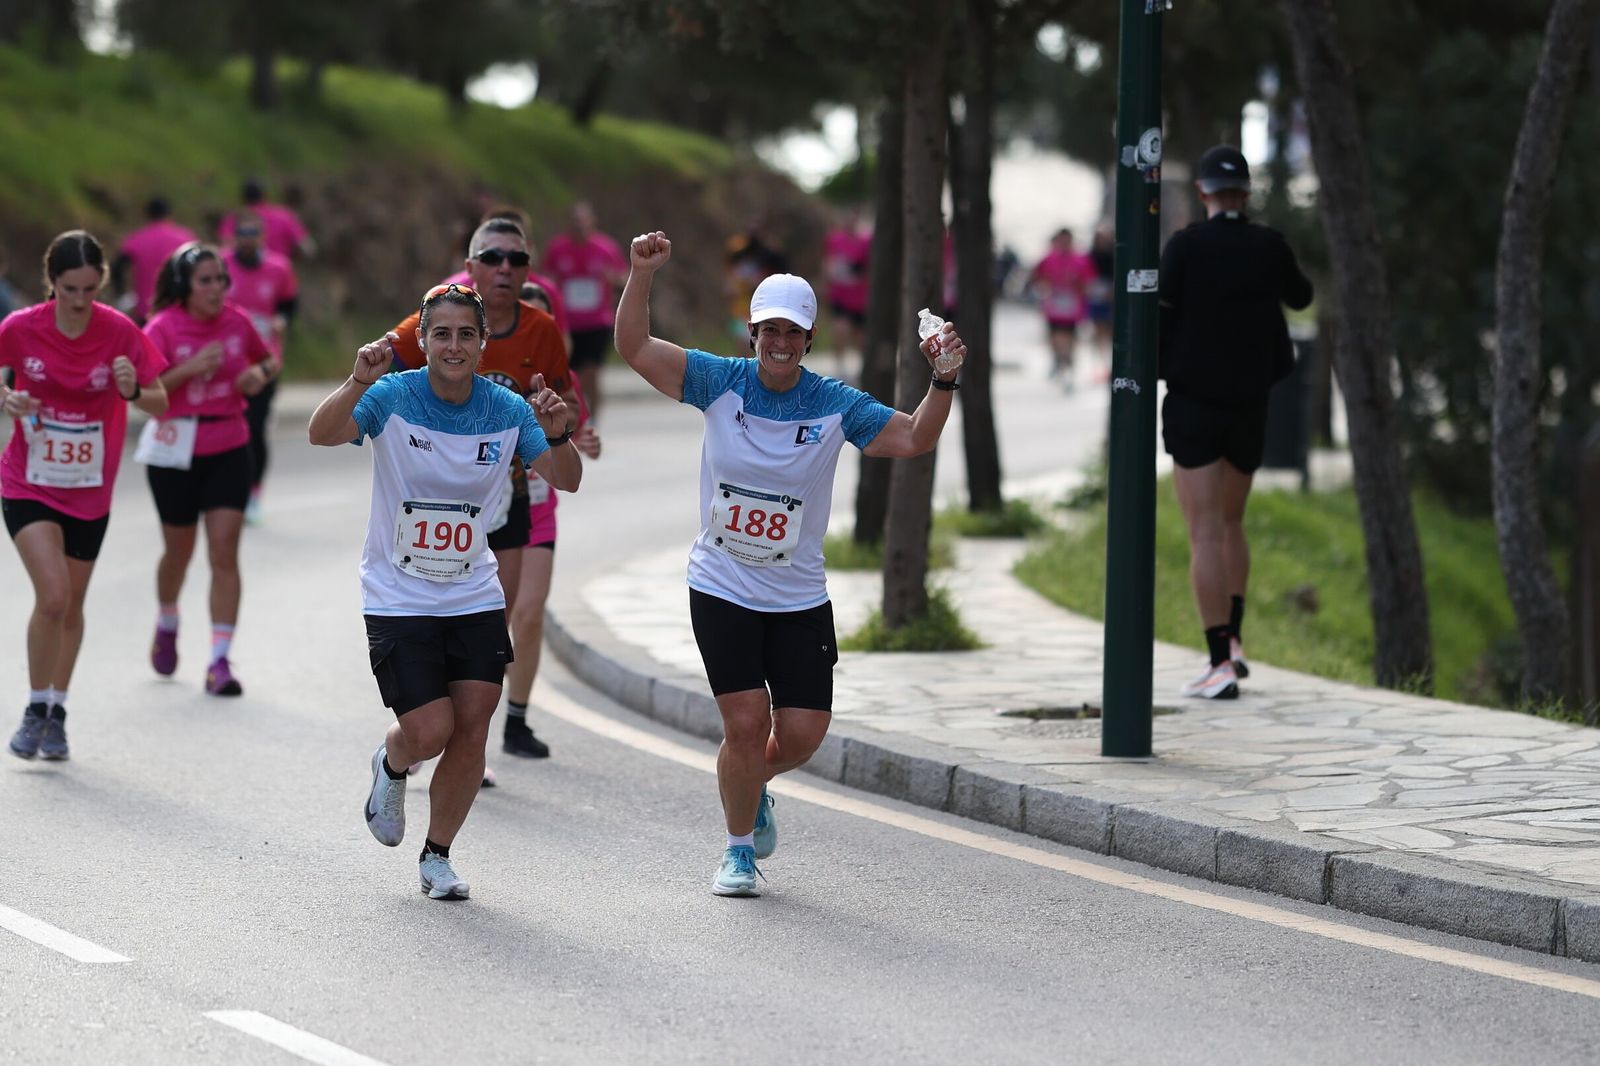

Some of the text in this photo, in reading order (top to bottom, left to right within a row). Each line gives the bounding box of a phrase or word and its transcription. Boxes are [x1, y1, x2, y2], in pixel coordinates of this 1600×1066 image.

[42, 439, 94, 464] 138
[417, 439, 431, 447] RUN
[412, 520, 473, 552] 190
[725, 504, 788, 541] 188
